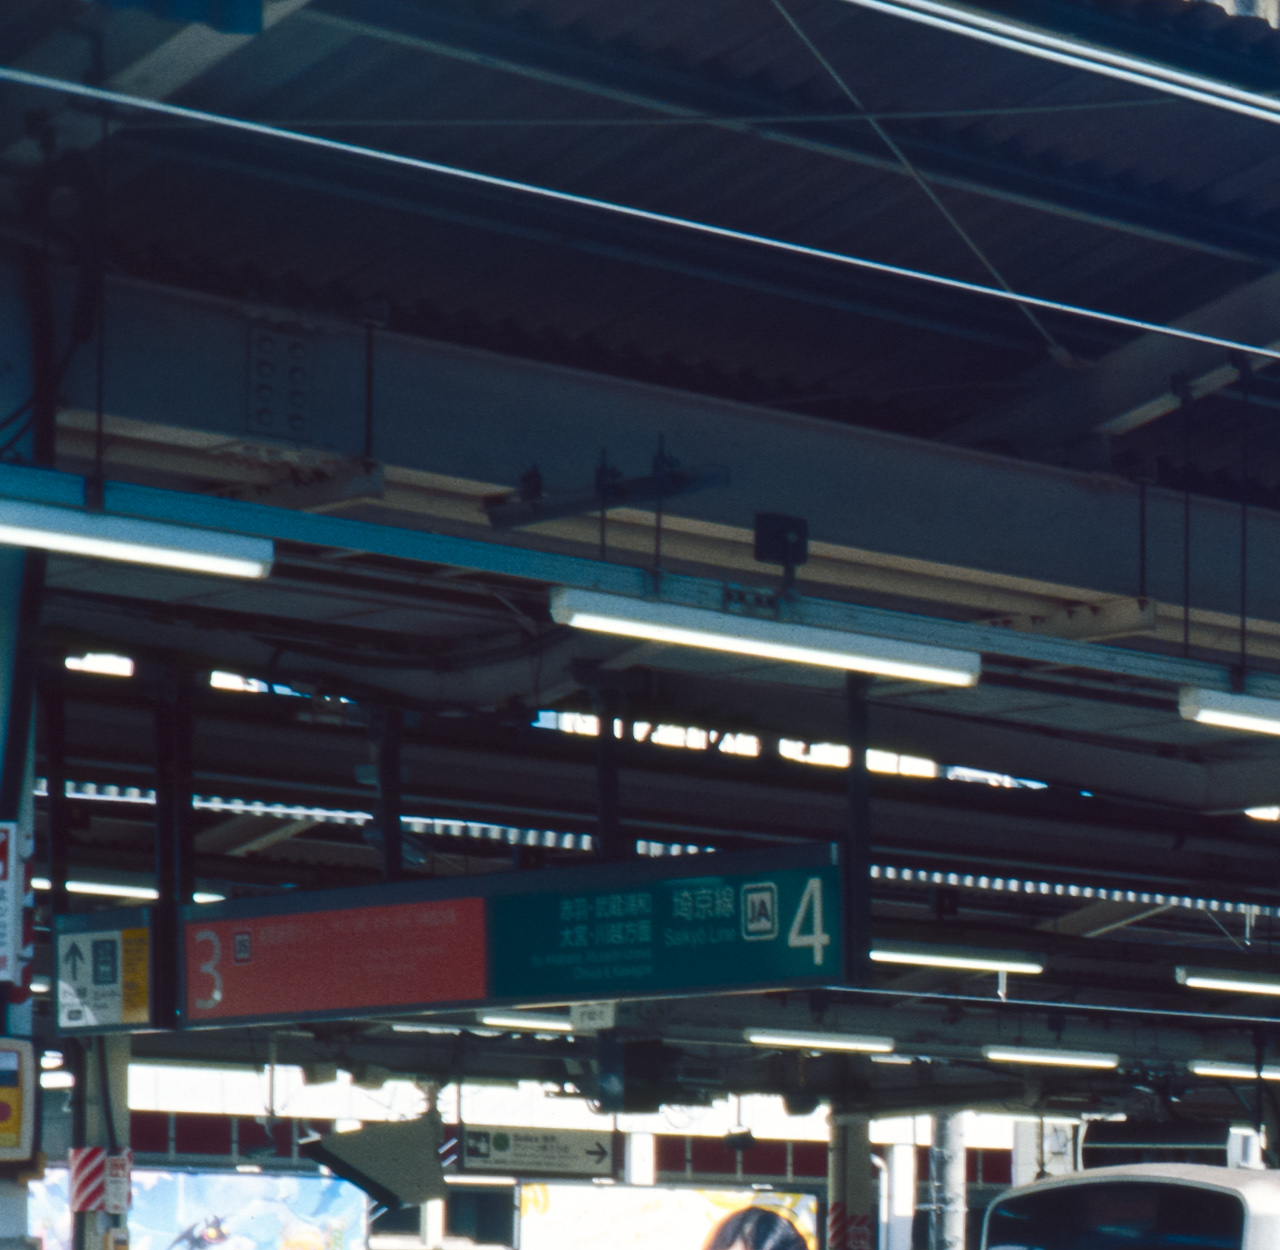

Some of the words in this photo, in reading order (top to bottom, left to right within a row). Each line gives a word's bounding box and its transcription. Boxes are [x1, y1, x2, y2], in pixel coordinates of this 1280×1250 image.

[672, 886, 736, 921] 埼京線
[787, 877, 831, 966] 4
[195, 931, 224, 1010] 3
